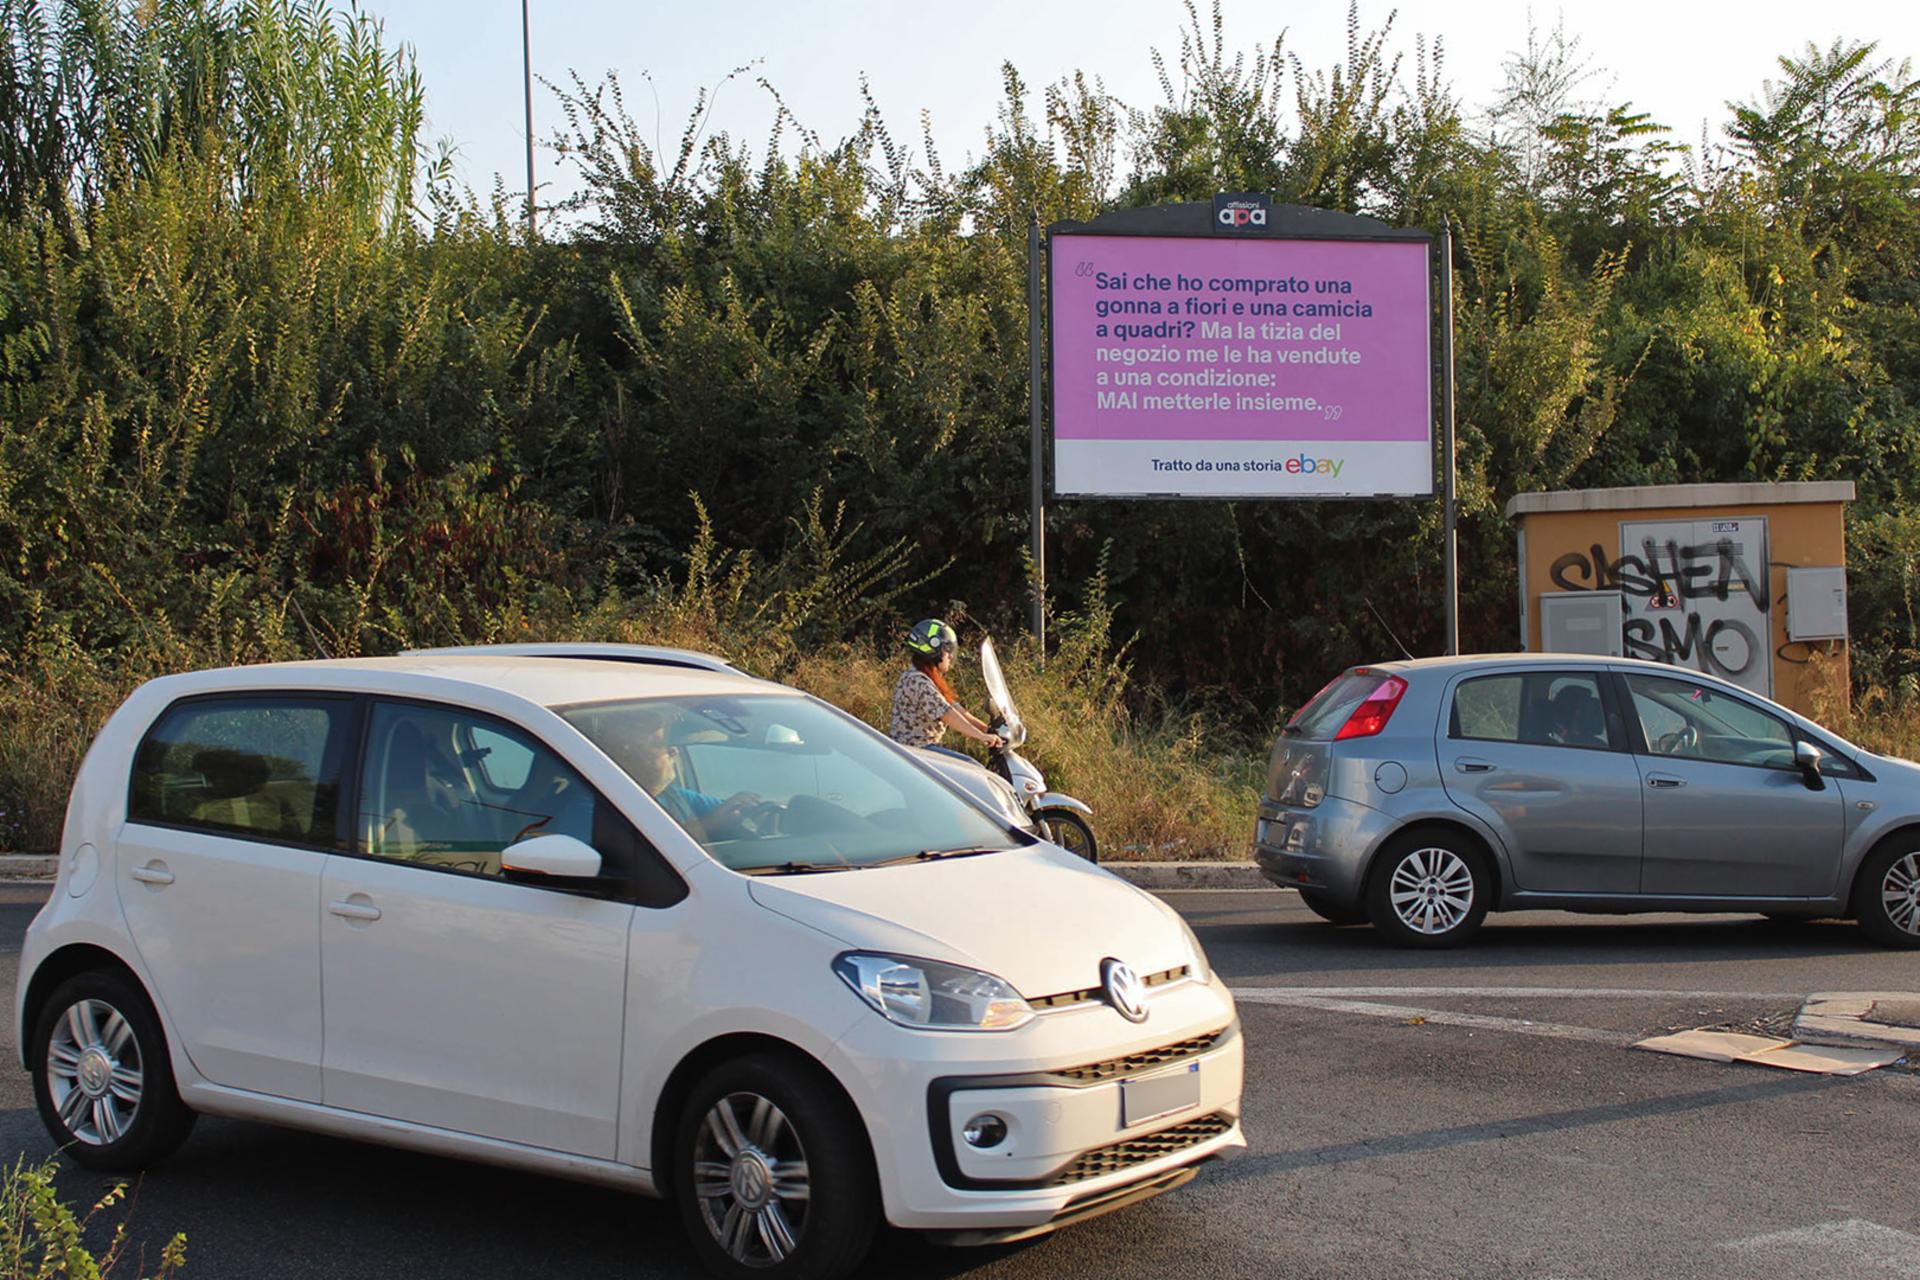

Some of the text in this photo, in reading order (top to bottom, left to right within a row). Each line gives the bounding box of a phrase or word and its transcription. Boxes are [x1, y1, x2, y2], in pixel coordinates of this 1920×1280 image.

[1218, 208, 1266, 227] apa
[1133, 273, 1172, 291] che
[1177, 273, 1203, 291] ho
[1208, 276, 1309, 296] comprato
[1315, 280, 1352, 294] una
[1096, 297, 1373, 318] gonna a fiori e una camicia
[1096, 320, 1341, 342] a quadri? Ma la tizia del
[1096, 344, 1361, 366] negozio me le ha vendute
[1096, 368, 1277, 387] a una condizione:
[1097, 391, 1137, 409] MAI
[1143, 392, 1231, 410] metterle
[1151, 453, 1344, 478] Tratto da una storia ebay
